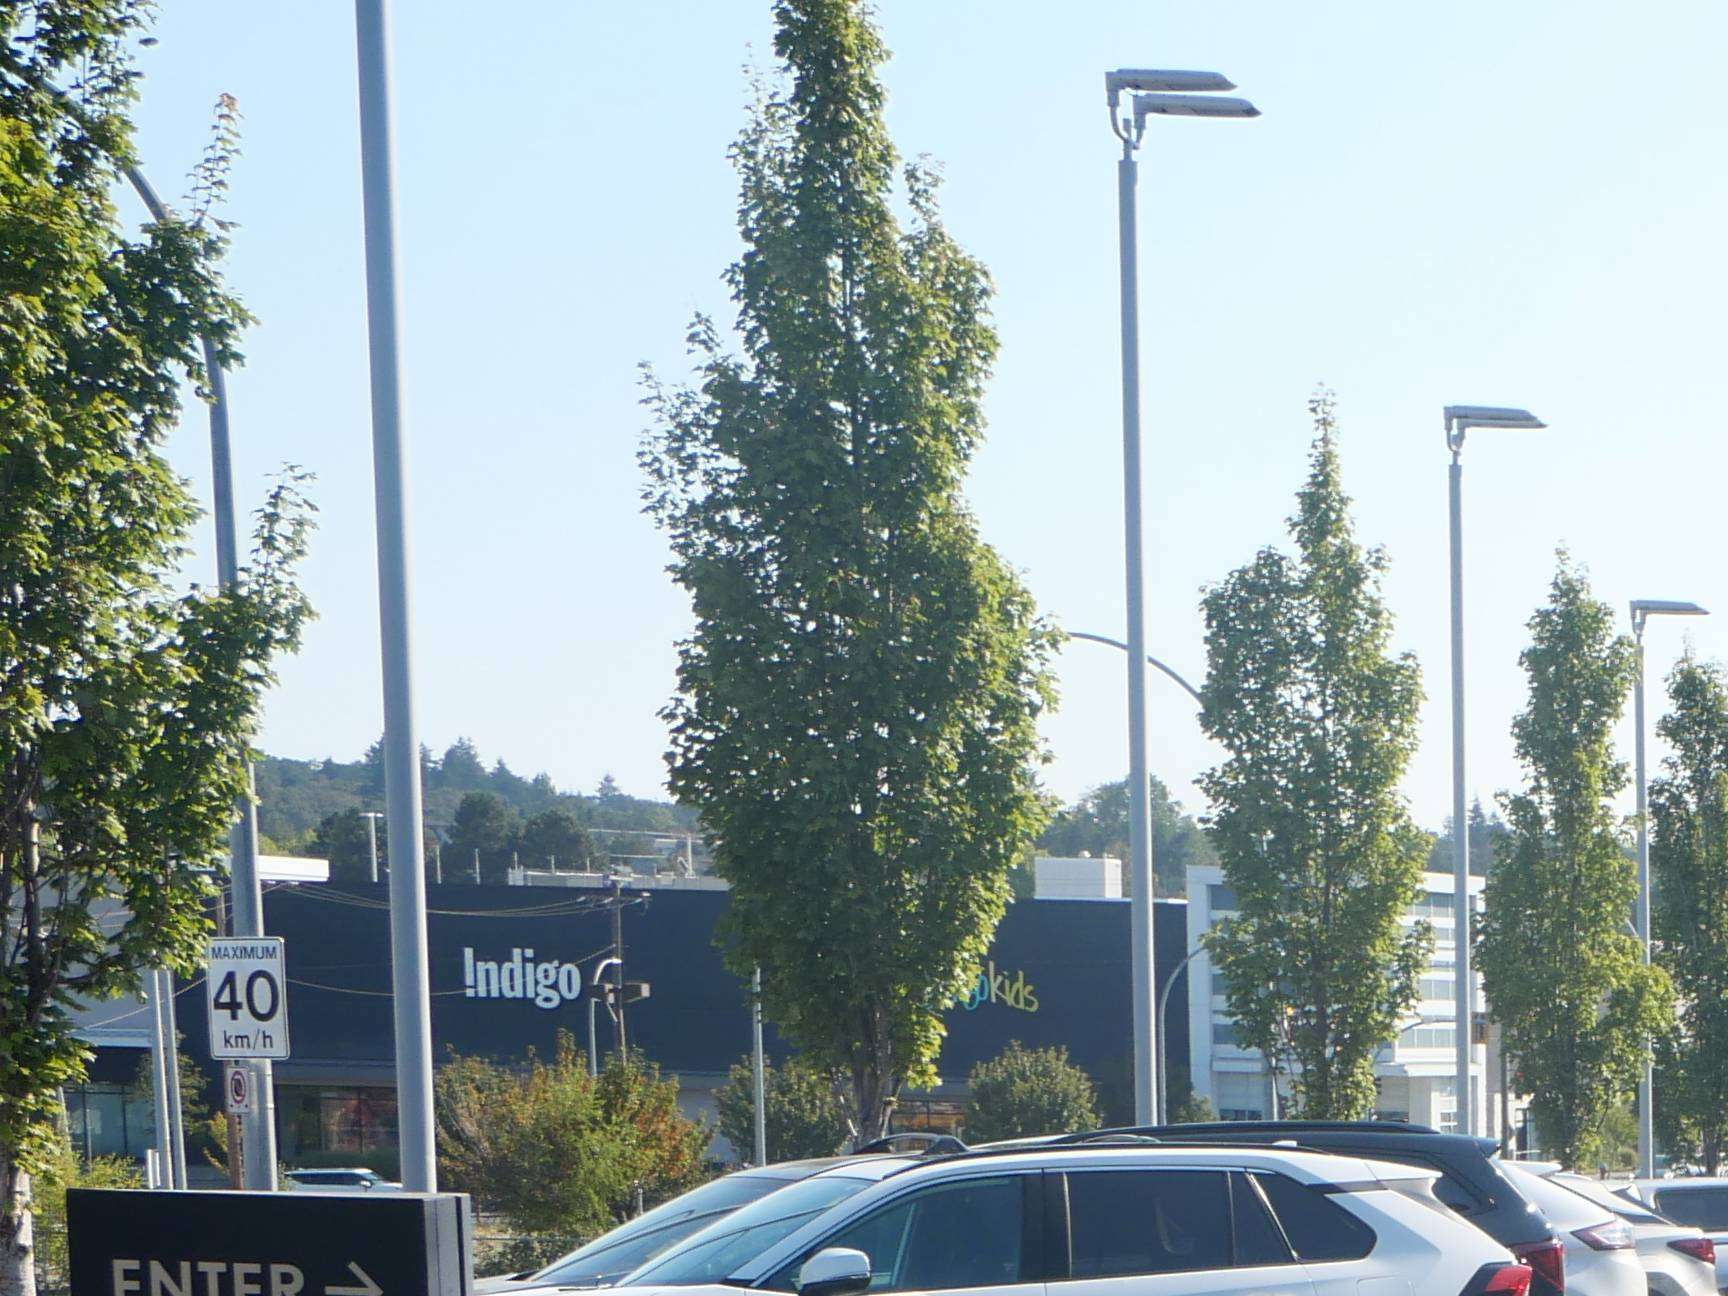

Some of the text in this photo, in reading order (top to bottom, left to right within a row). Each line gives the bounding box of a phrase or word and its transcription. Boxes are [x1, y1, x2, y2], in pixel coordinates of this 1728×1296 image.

[211, 945, 277, 960] MAXIMUM
[213, 969, 280, 1022] 40
[224, 1028, 273, 1050] km/h
